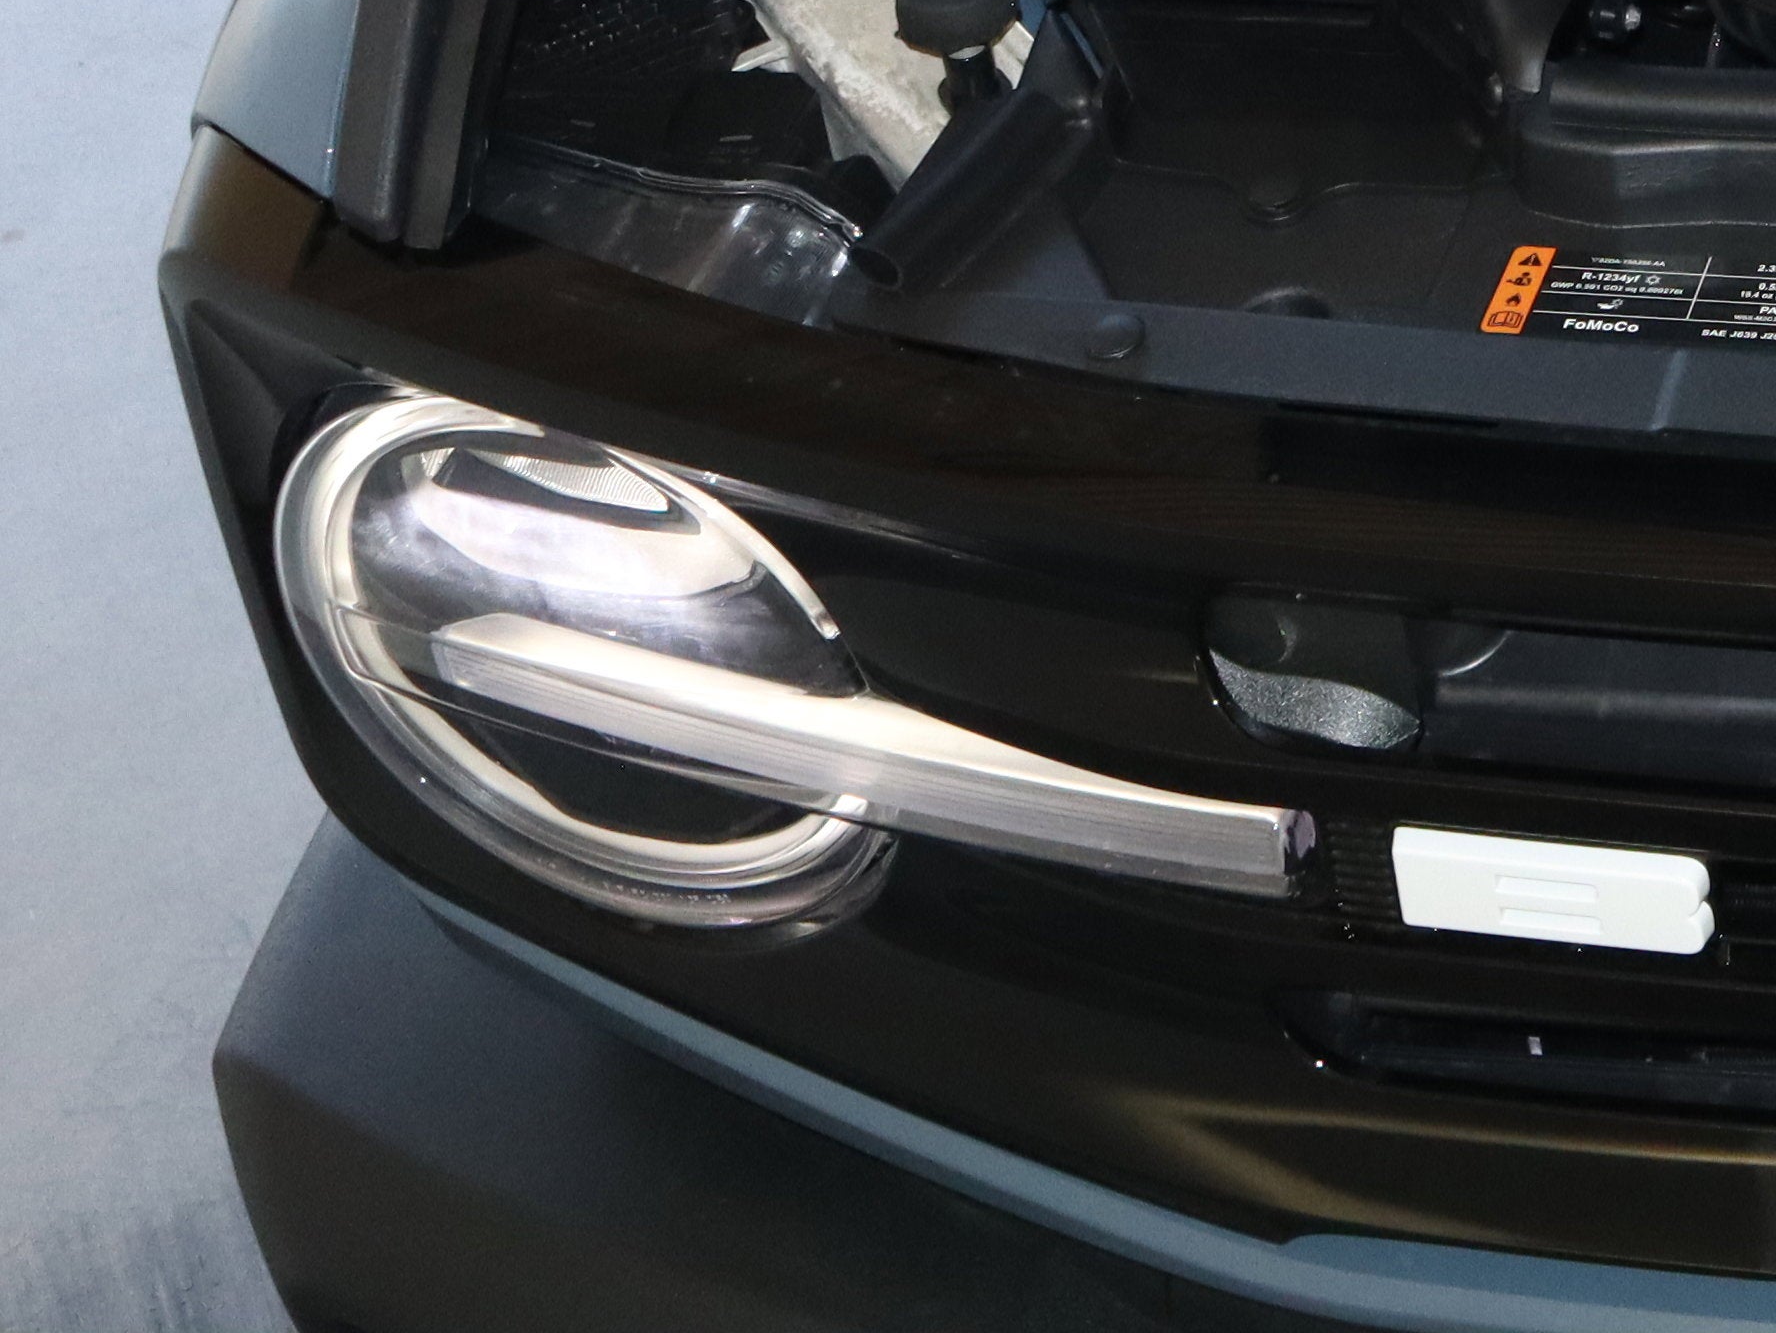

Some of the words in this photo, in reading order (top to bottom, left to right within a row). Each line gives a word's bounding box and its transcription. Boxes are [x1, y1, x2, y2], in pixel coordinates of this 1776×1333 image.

[1581, 271, 1641, 284] R-1234yf
[1550, 281, 1575, 289] GWP
[1562, 318, 1640, 334] FoMoCo
[1700, 328, 1727, 338] SAE
[1729, 330, 1758, 339] J639
